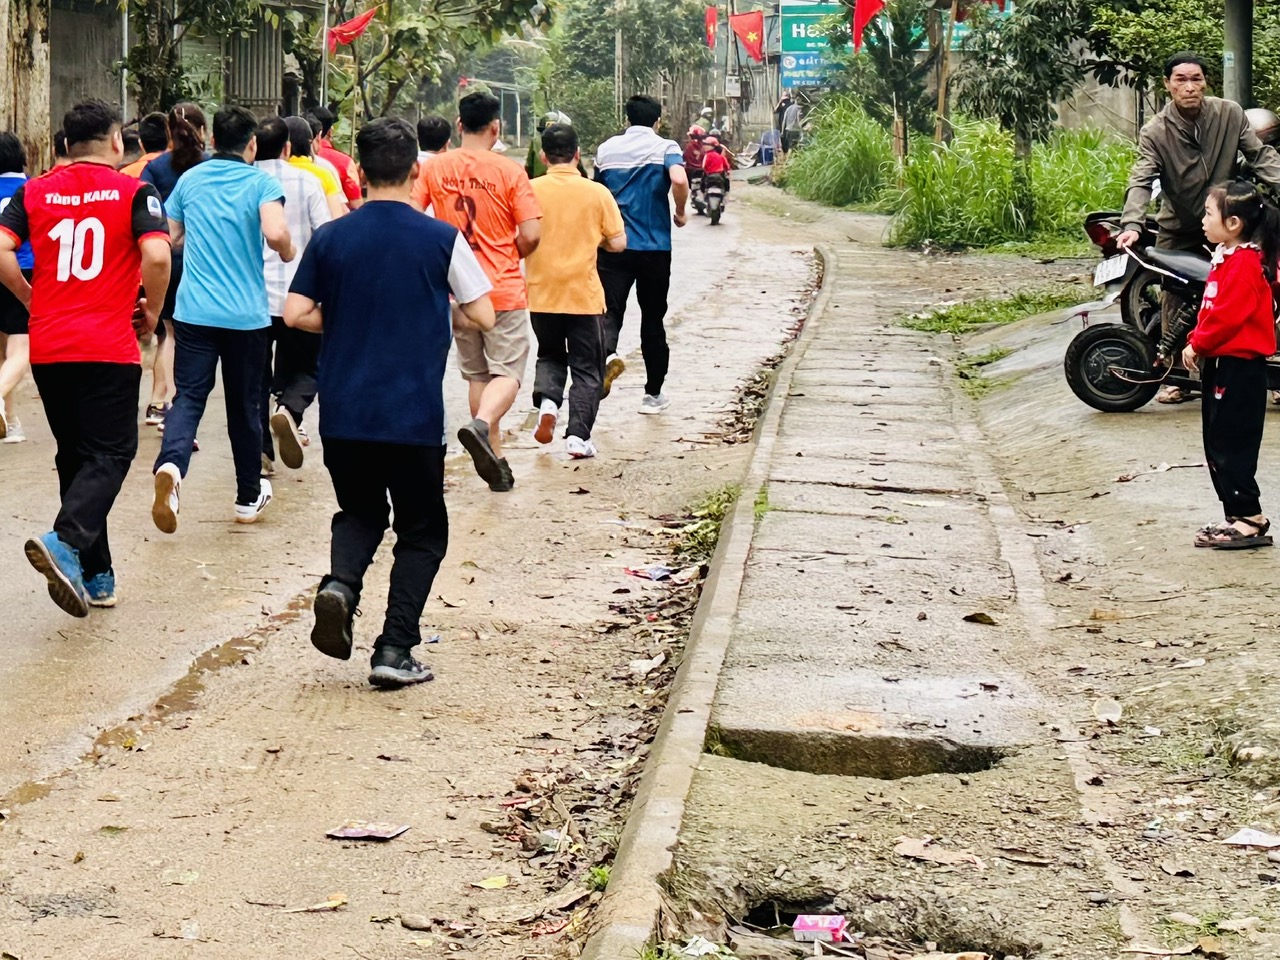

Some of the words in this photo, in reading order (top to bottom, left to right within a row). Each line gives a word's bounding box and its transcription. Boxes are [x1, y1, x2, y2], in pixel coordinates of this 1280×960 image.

[45, 192, 81, 207] Tùng
[83, 189, 121, 204] KAKA
[47, 216, 106, 283] 10
